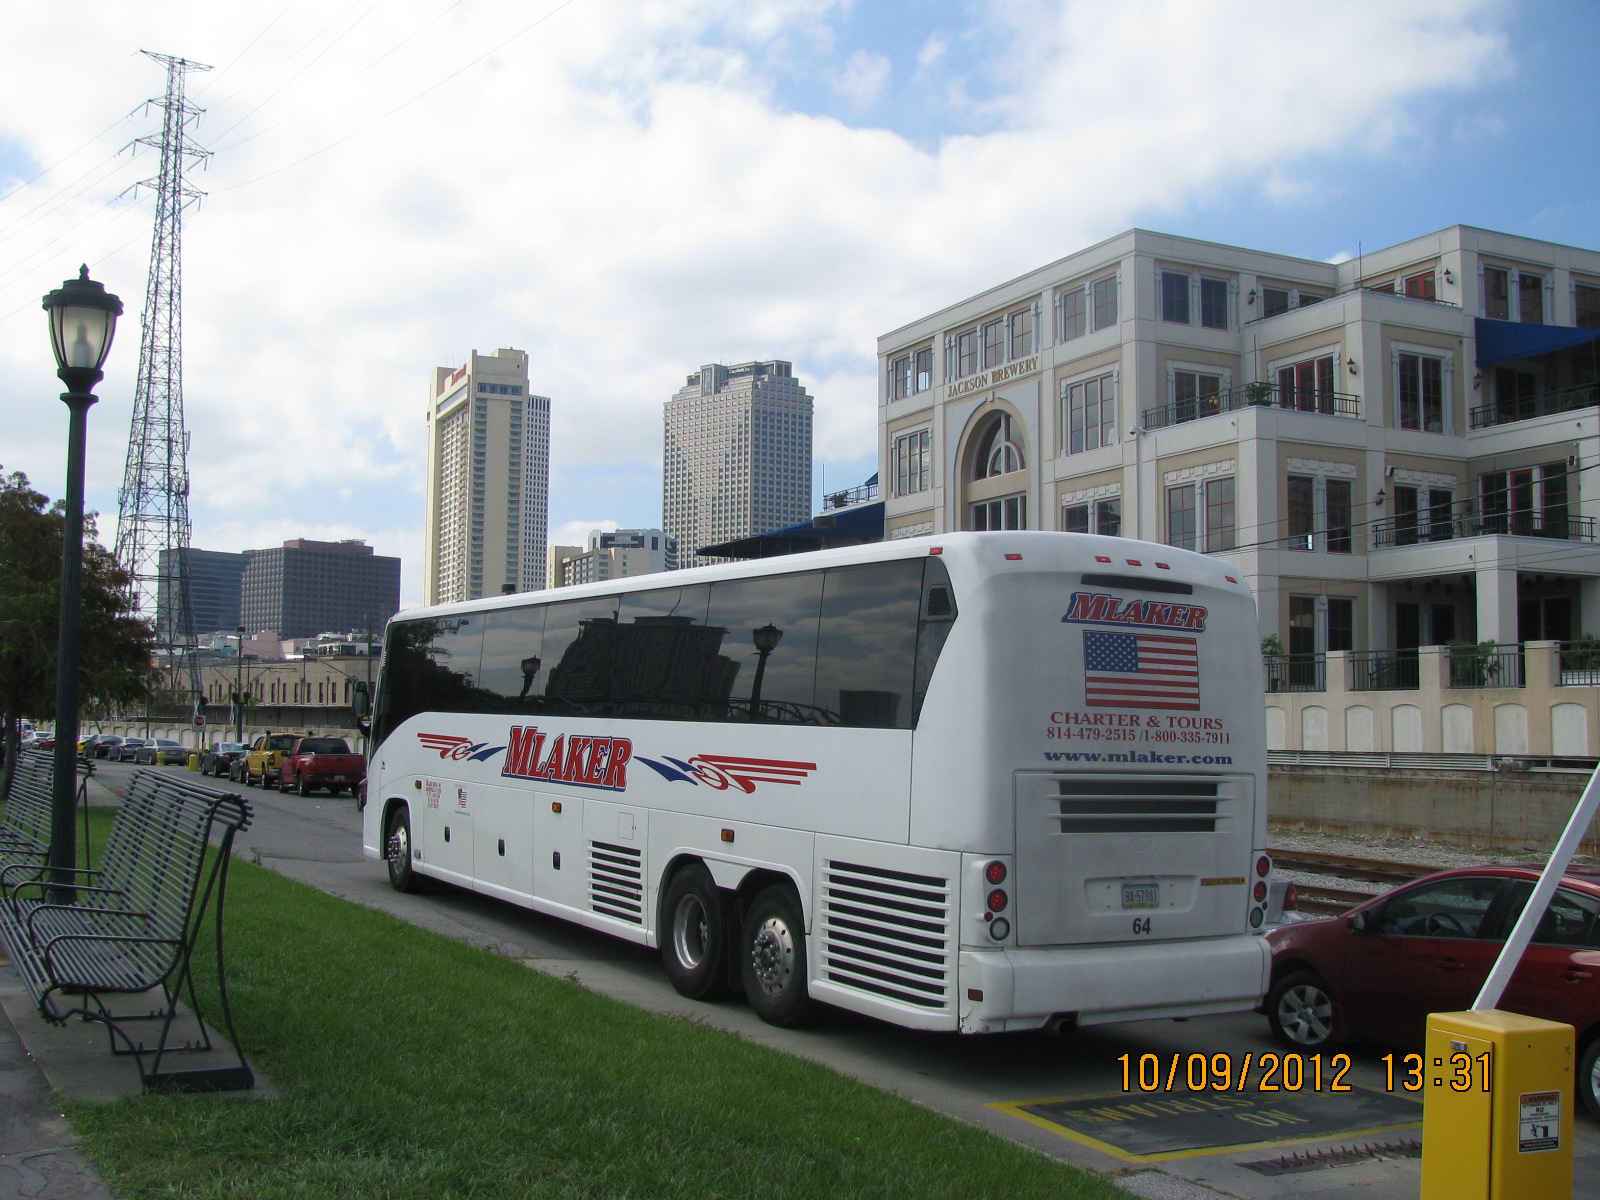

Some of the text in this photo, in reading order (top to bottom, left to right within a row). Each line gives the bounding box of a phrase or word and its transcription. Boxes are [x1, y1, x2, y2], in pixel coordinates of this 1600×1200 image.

[947, 356, 1038, 398] JACKSON BREWERY
[1061, 592, 1208, 633] MLAKER
[1050, 712, 1223, 730] CHARTER & TOURS
[1047, 727, 1136, 742] 814-479-2515
[501, 725, 634, 792] MLAKER
[1044, 751, 1232, 765] www.mlaker.com
[1132, 917, 1151, 934] 64
